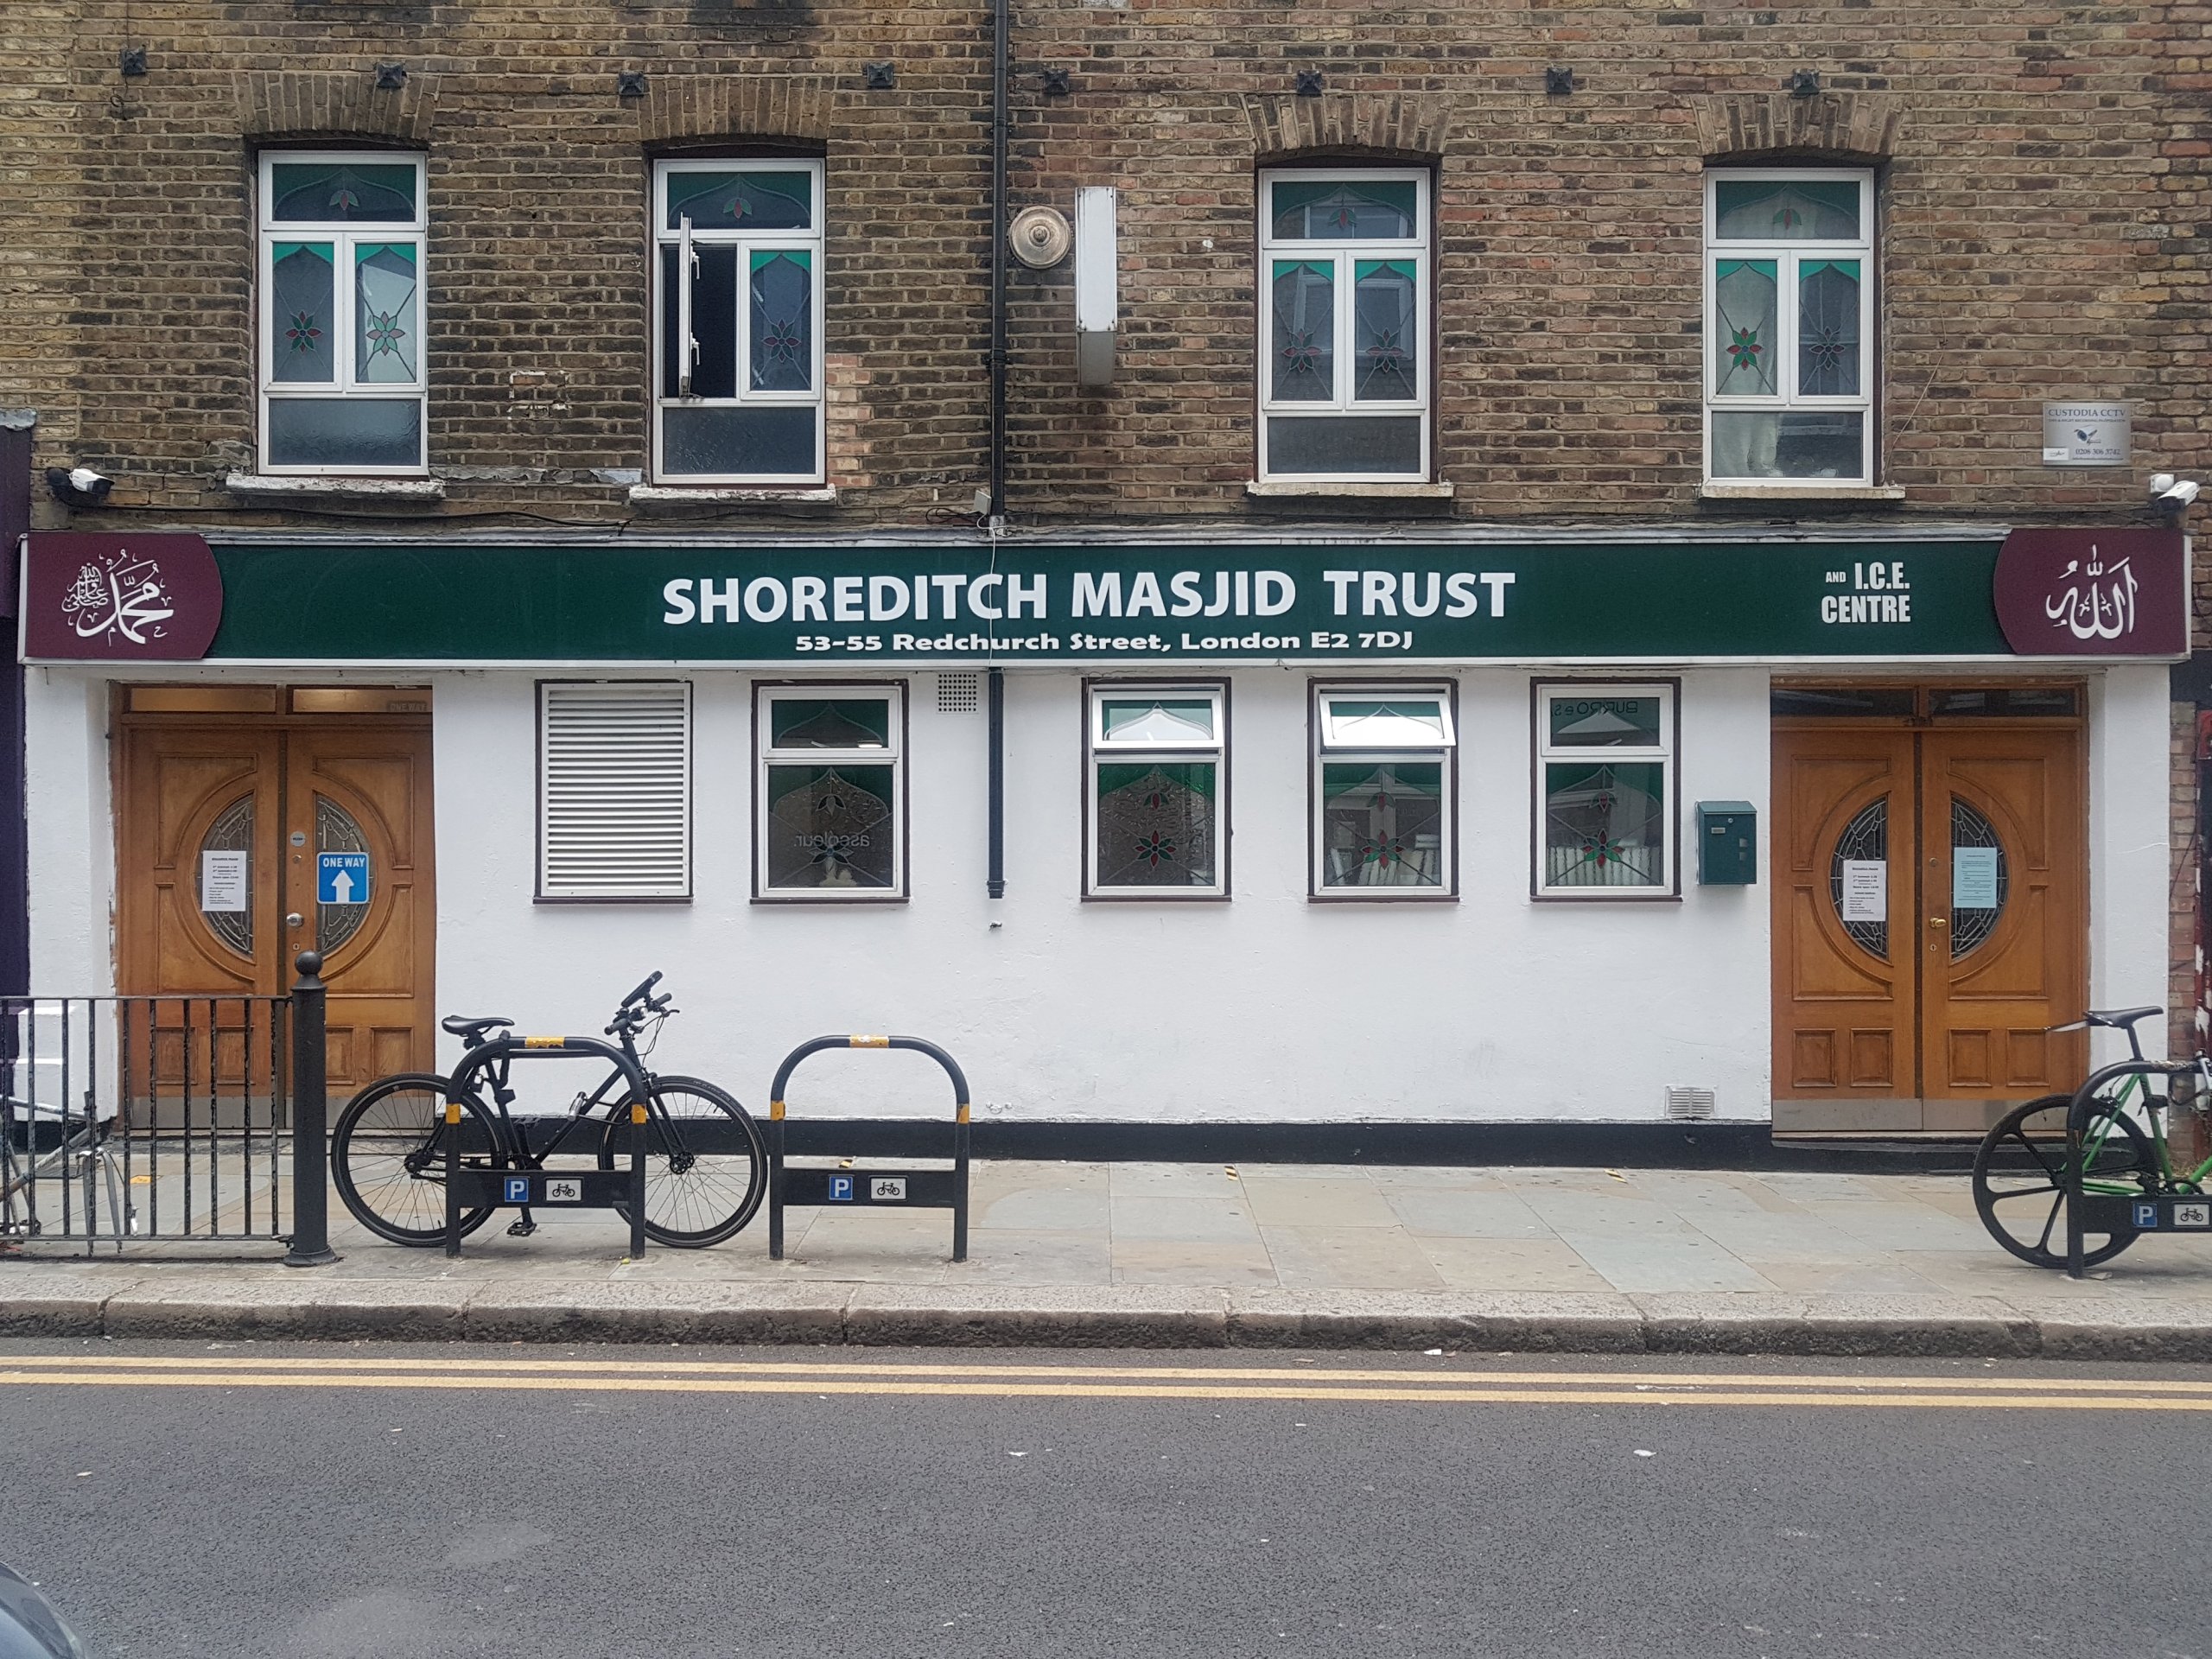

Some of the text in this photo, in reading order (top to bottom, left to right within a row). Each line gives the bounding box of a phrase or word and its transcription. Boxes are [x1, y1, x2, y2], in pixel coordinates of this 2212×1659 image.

[1825, 562, 1910, 590] AND I.C.E.
[663, 570, 1516, 625] SHOREDITCH MASJID TRUST
[1821, 594, 1911, 624] CENTRE
[795, 631, 1413, 652] 53-55 Redchurch Street, London E2 7DJ
[322, 857, 365, 868] ONE WAY
[510, 1180, 524, 1199] P
[835, 1179, 849, 1198] P
[2139, 1205, 2153, 1224] P
